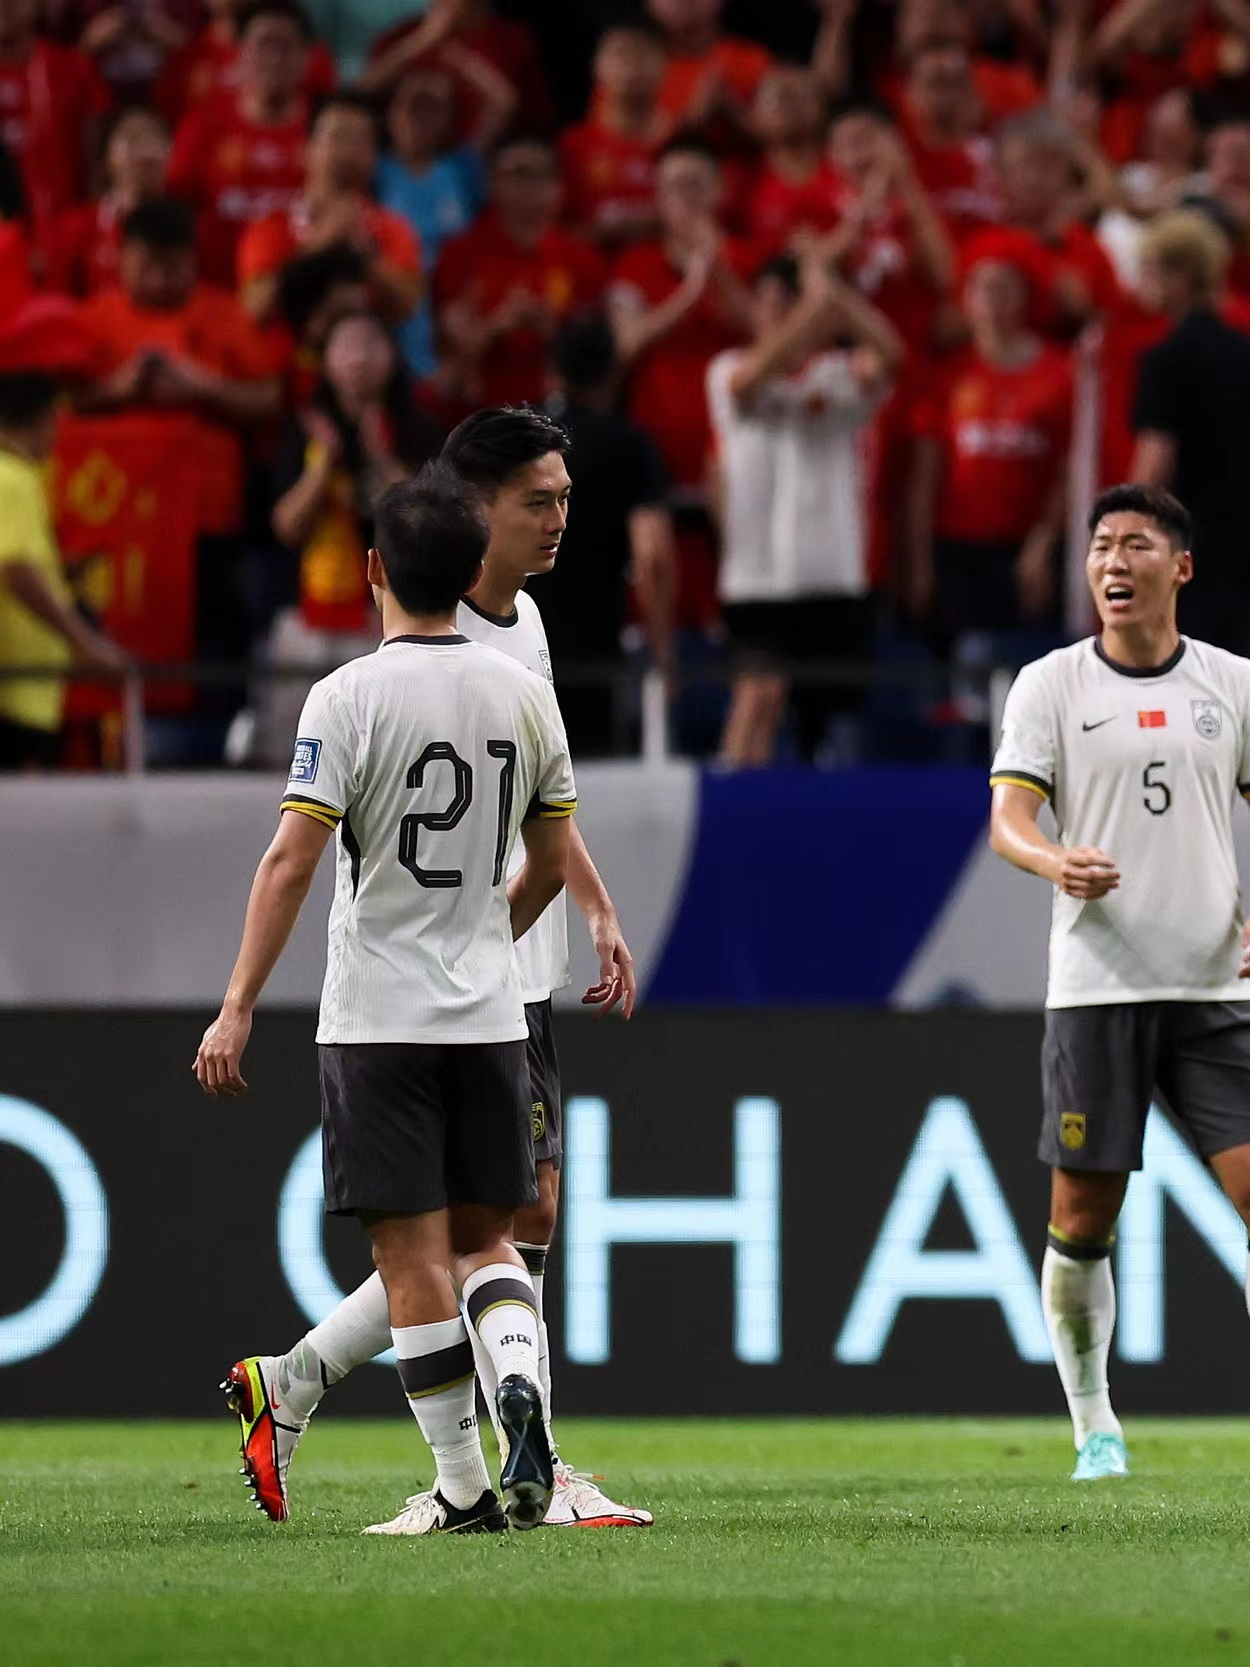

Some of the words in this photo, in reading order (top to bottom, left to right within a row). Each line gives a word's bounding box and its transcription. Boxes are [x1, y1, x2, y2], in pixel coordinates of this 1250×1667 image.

[1143, 762, 1171, 815] 5
[398, 740, 516, 888] 21
[500, 1333, 532, 1347] 中国
[459, 1415, 477, 1430] 中
